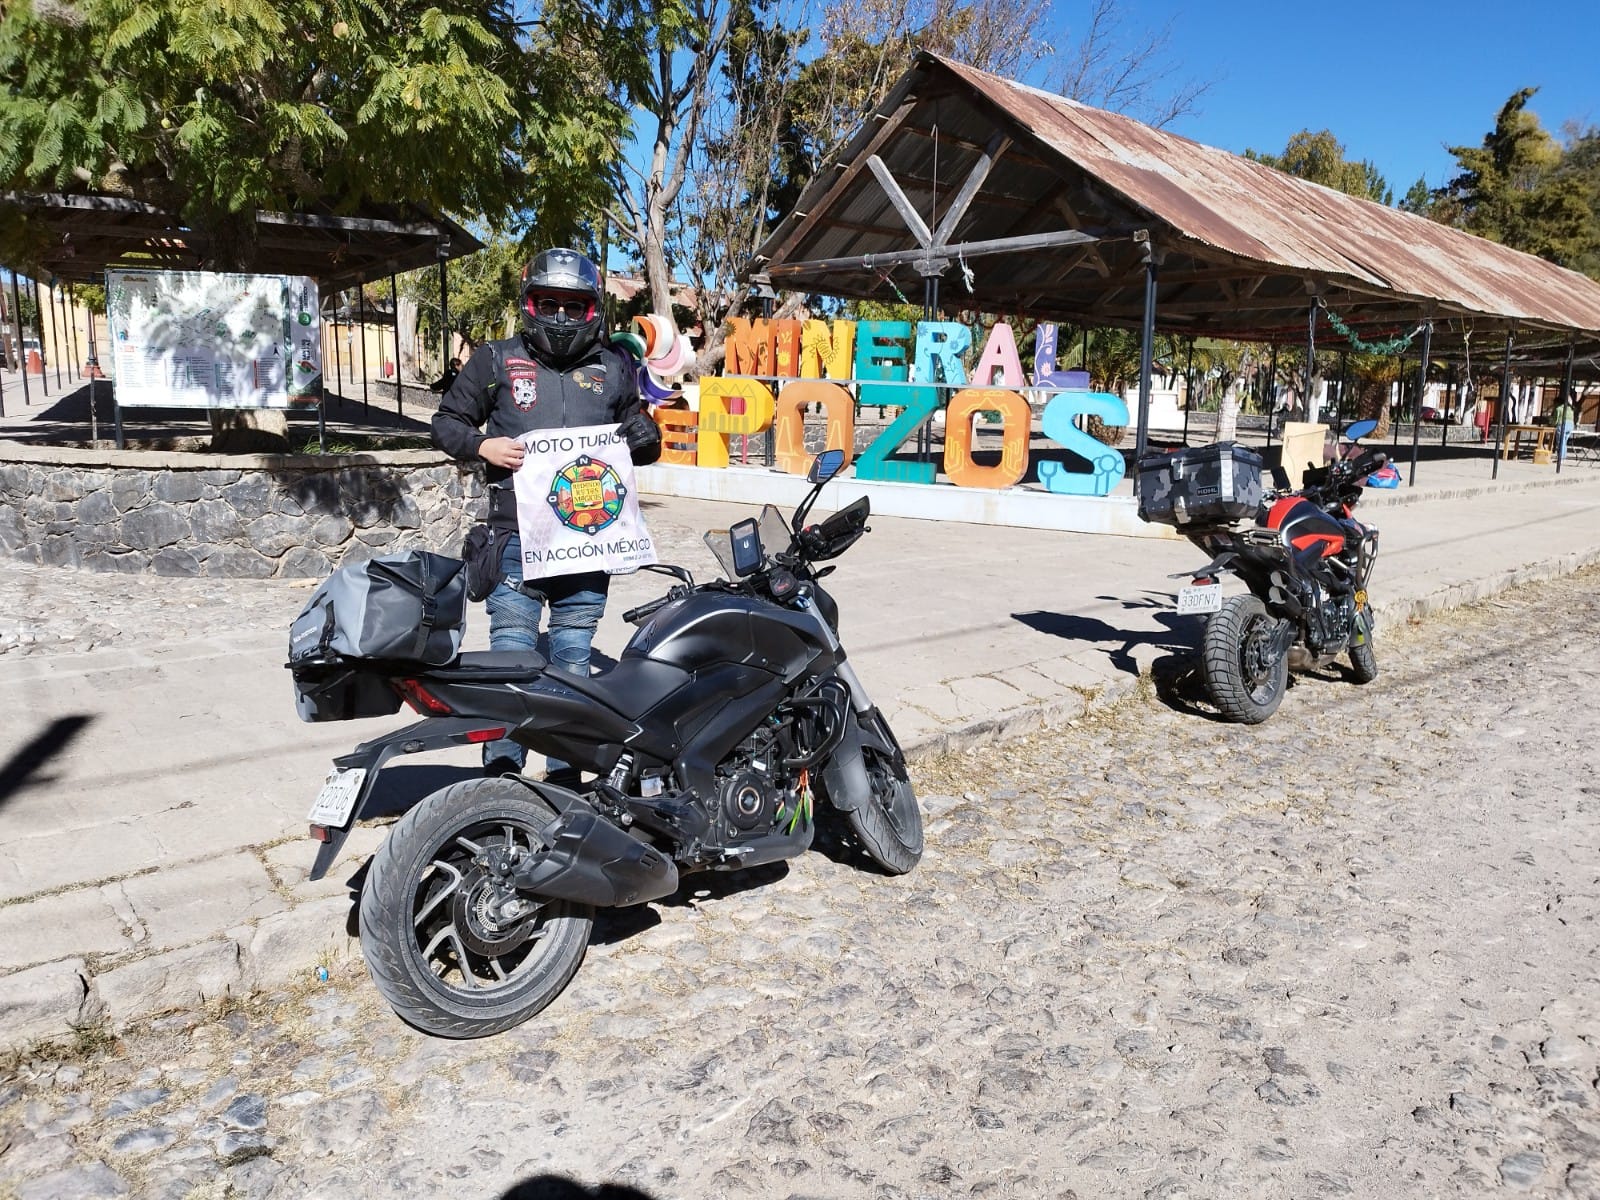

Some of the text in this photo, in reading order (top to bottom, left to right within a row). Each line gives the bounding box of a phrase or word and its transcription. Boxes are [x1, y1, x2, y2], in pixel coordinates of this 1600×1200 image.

[724, 316, 1090, 388] MINERAL
[524, 438, 573, 454] MOTO
[699, 375, 1131, 496] POZOS
[524, 550, 546, 564] EN
[546, 541, 604, 562] ACCIÓN
[607, 537, 651, 555] MÉXICO
